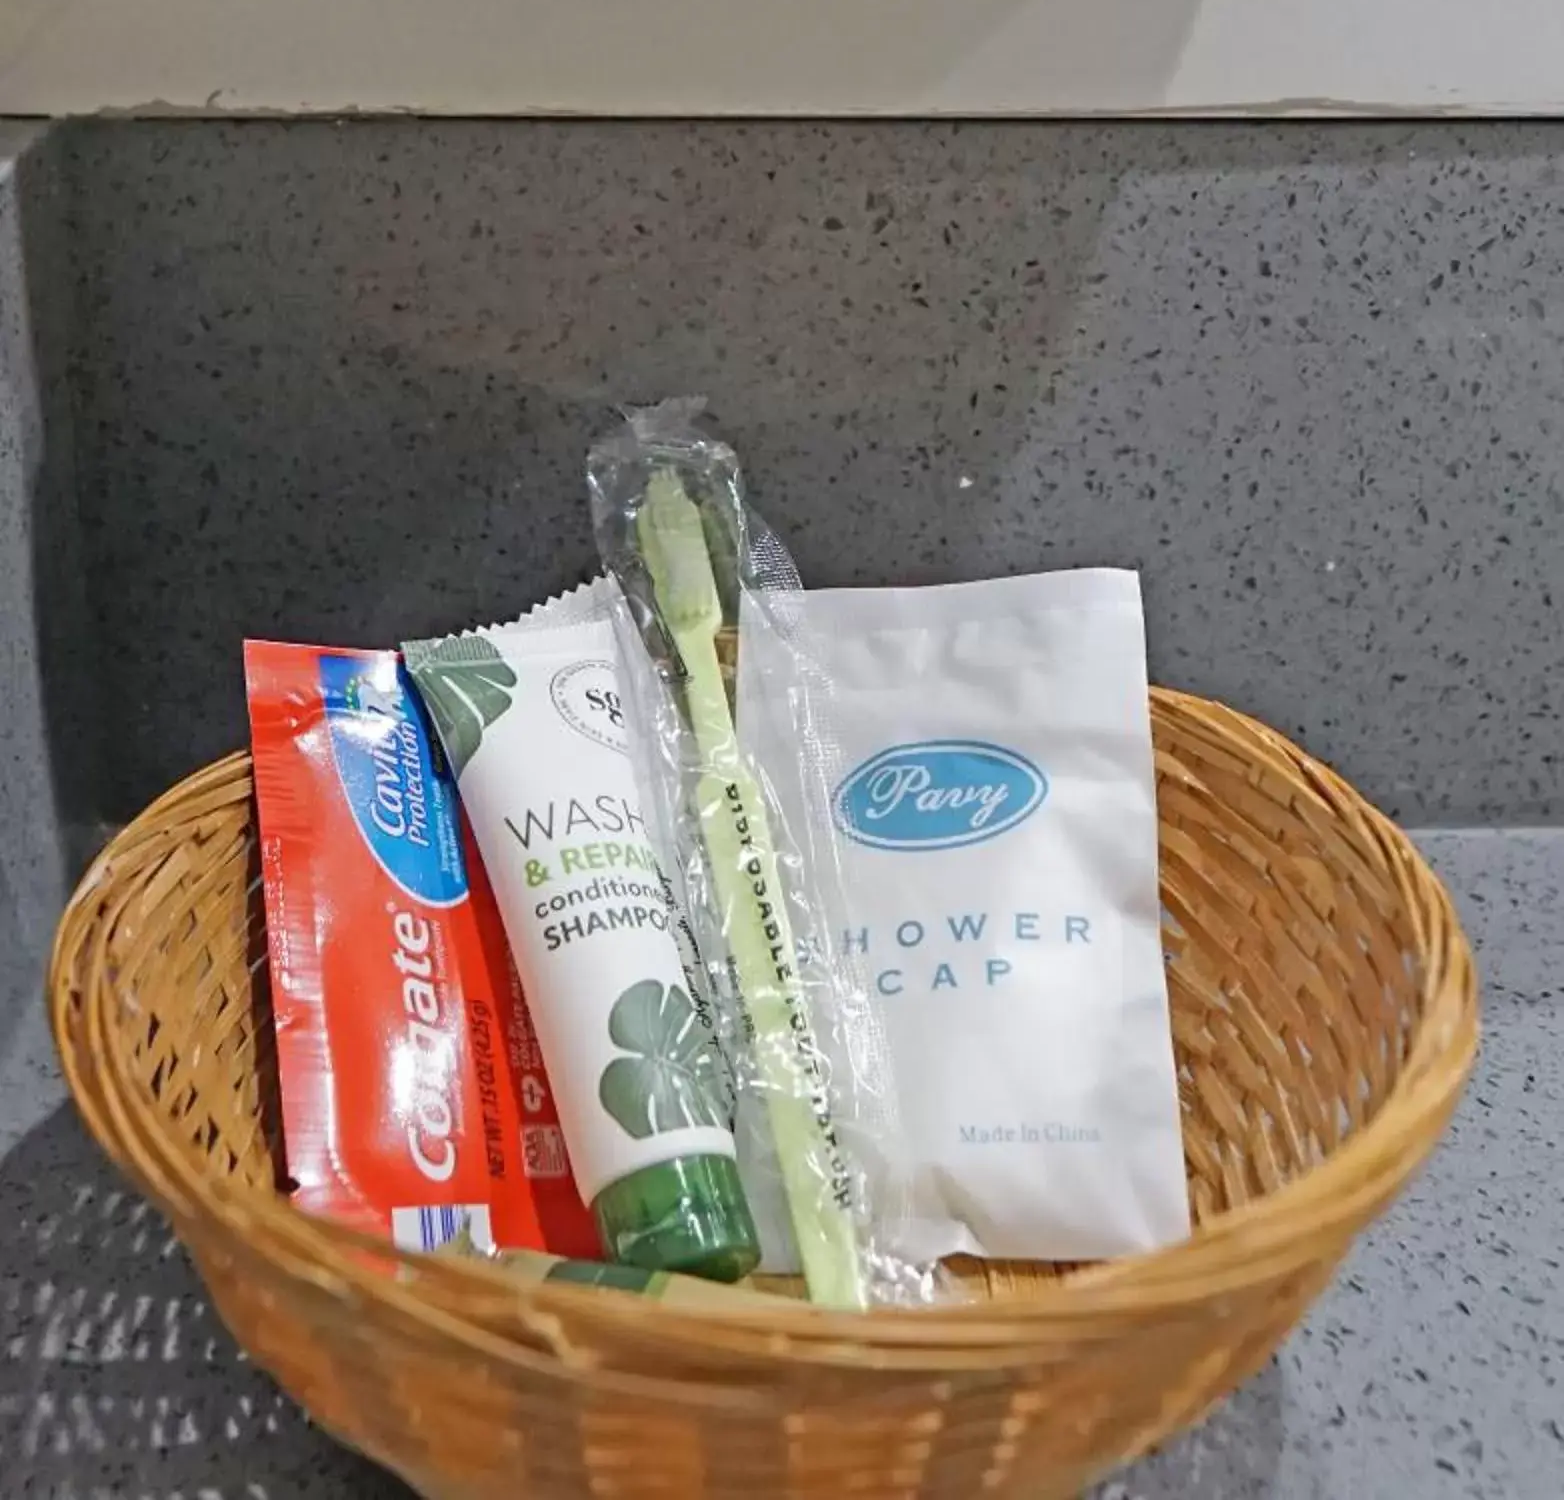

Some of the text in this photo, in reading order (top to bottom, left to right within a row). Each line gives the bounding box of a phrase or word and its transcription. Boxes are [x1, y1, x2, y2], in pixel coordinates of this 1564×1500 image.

[400, 721, 431, 848] Protection
[865, 763, 1012, 829] Pavy
[504, 794, 650, 850] WASH
[523, 858, 552, 888] &
[534, 875, 667, 920] condition
[876, 957, 1014, 996] CAP
[392, 911, 457, 1183] Cogate
[482, 1112, 502, 1142] WT
[958, 1122, 1016, 1144] Made
[1043, 1121, 1102, 1143] China
[486, 1141, 506, 1179] NET
